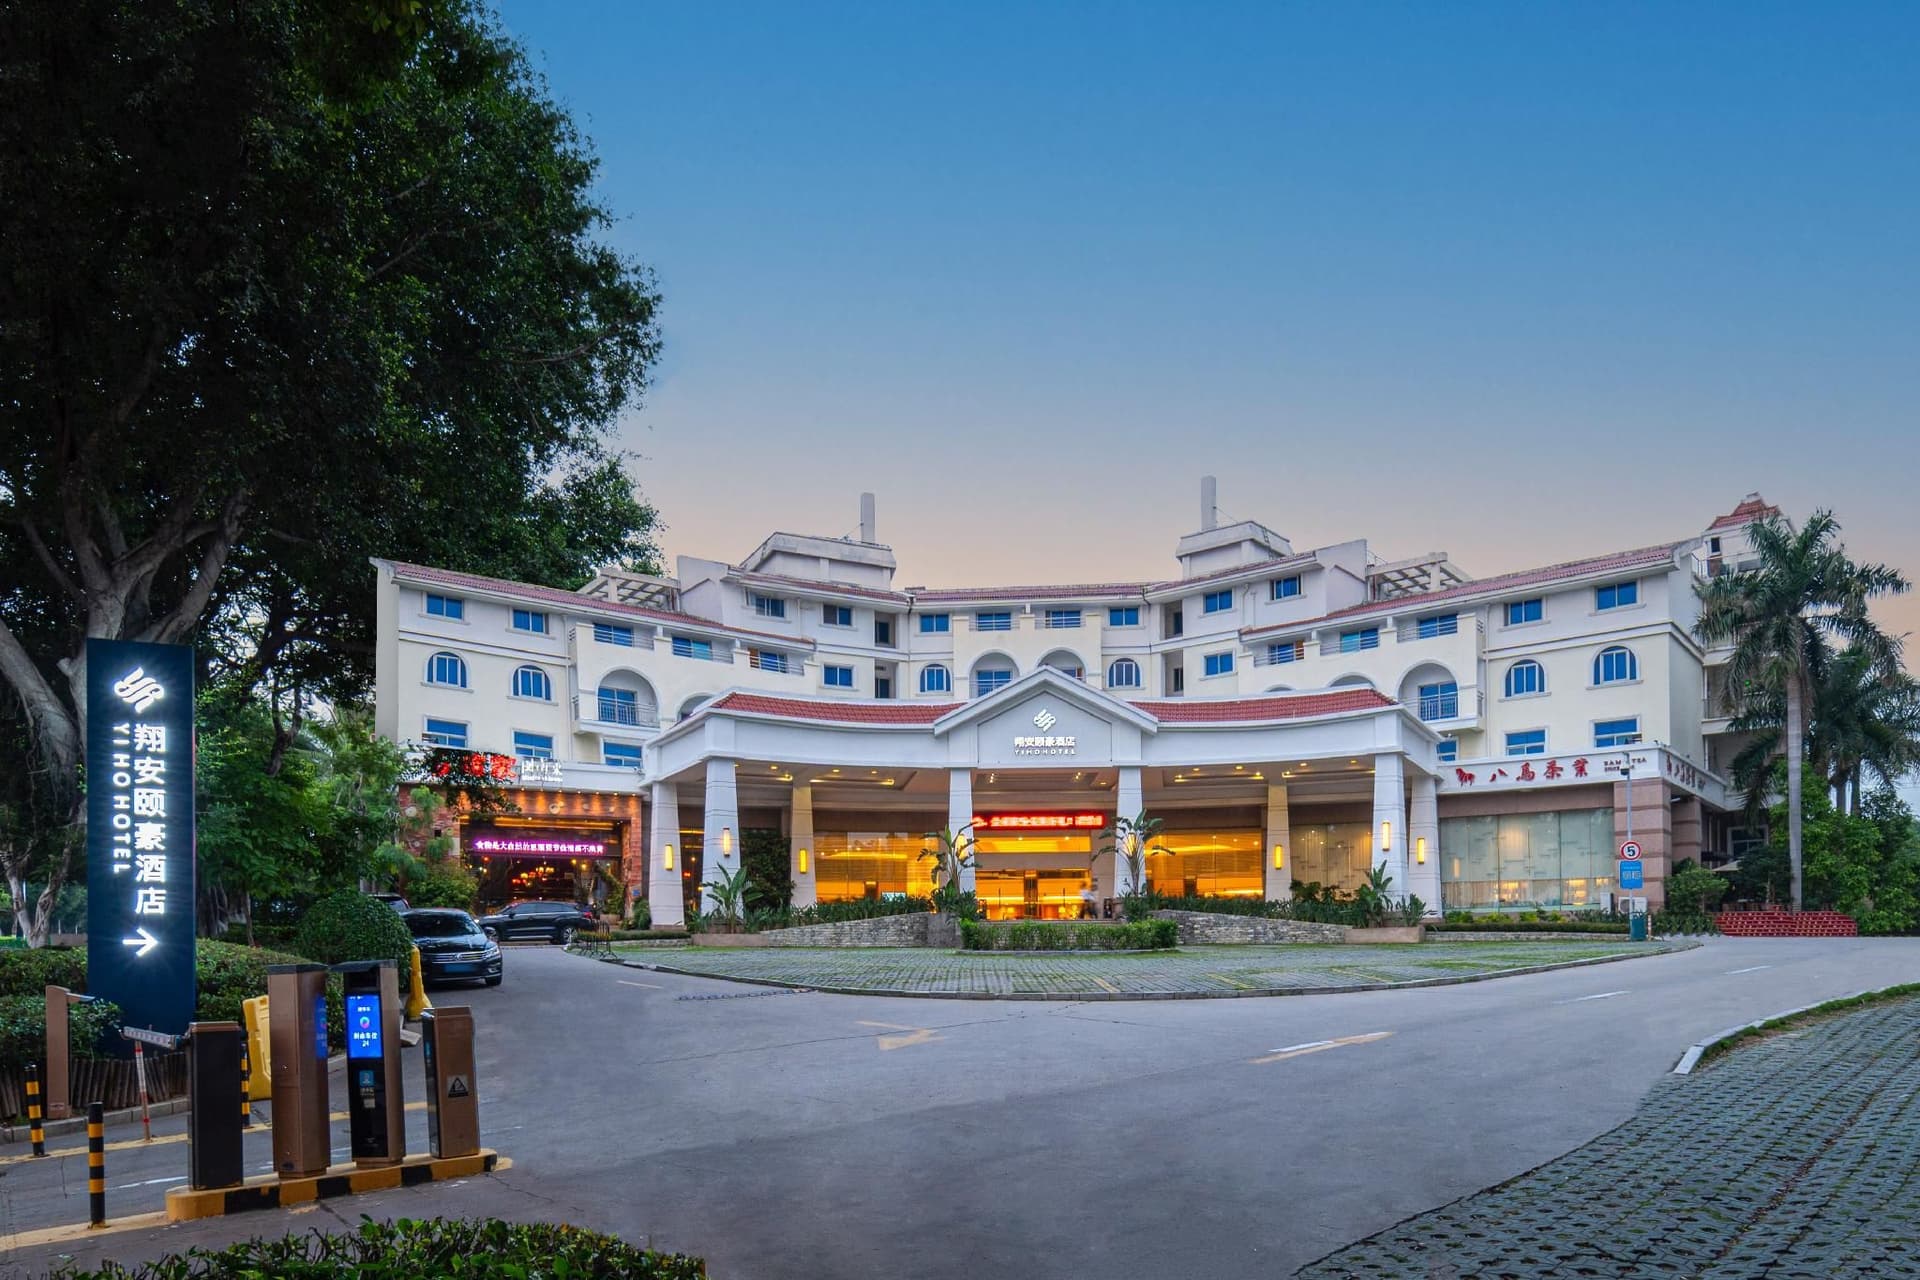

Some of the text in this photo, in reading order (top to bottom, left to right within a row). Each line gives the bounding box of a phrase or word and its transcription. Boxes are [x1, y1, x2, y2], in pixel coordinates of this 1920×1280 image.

[112, 794, 131, 874] HOTEL
[133, 723, 167, 914] 翔安颐豪酒店
[1626, 845, 1637, 857] 5
